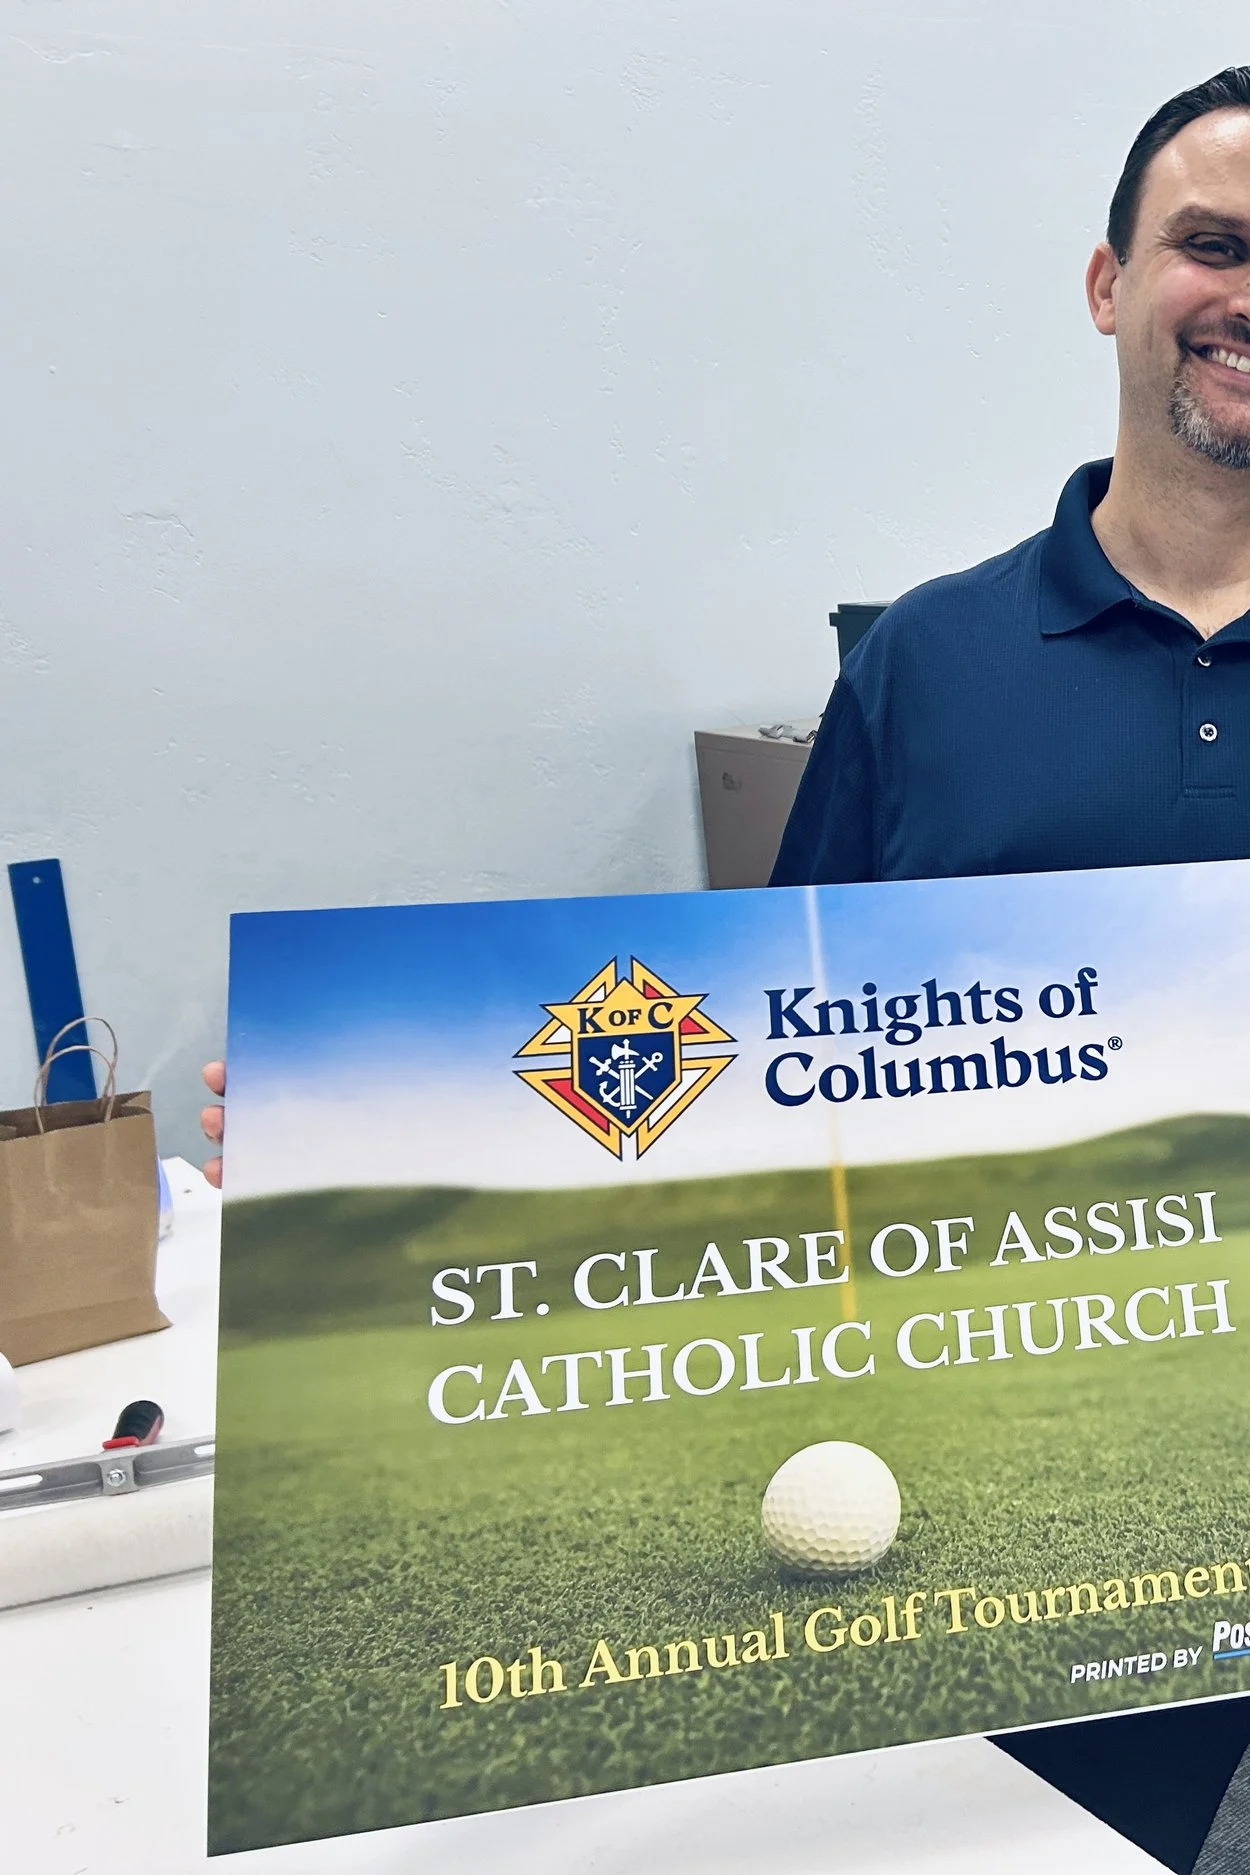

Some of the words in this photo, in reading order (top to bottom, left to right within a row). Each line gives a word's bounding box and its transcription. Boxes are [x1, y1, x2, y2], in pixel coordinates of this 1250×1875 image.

[577, 1007, 607, 1034] K
[608, 1008, 642, 1027] OF
[647, 1002, 674, 1030] C
[763, 977, 1024, 1046] Knights
[1039, 966, 1098, 1018] of
[431, 1260, 550, 1326] ST.
[573, 1229, 850, 1309] CLARE
[869, 1215, 975, 1278] OF
[989, 1190, 1224, 1268] ASSISI
[427, 1319, 876, 1425] CATHOLIC
[896, 1278, 1237, 1370] CHURCH
[439, 1645, 568, 1709] 10th
[578, 1611, 790, 1688] Annual
[803, 1592, 928, 1654] Golf
[1070, 1653, 1168, 1684] PRINTED
[1172, 1646, 1204, 1669] BY
